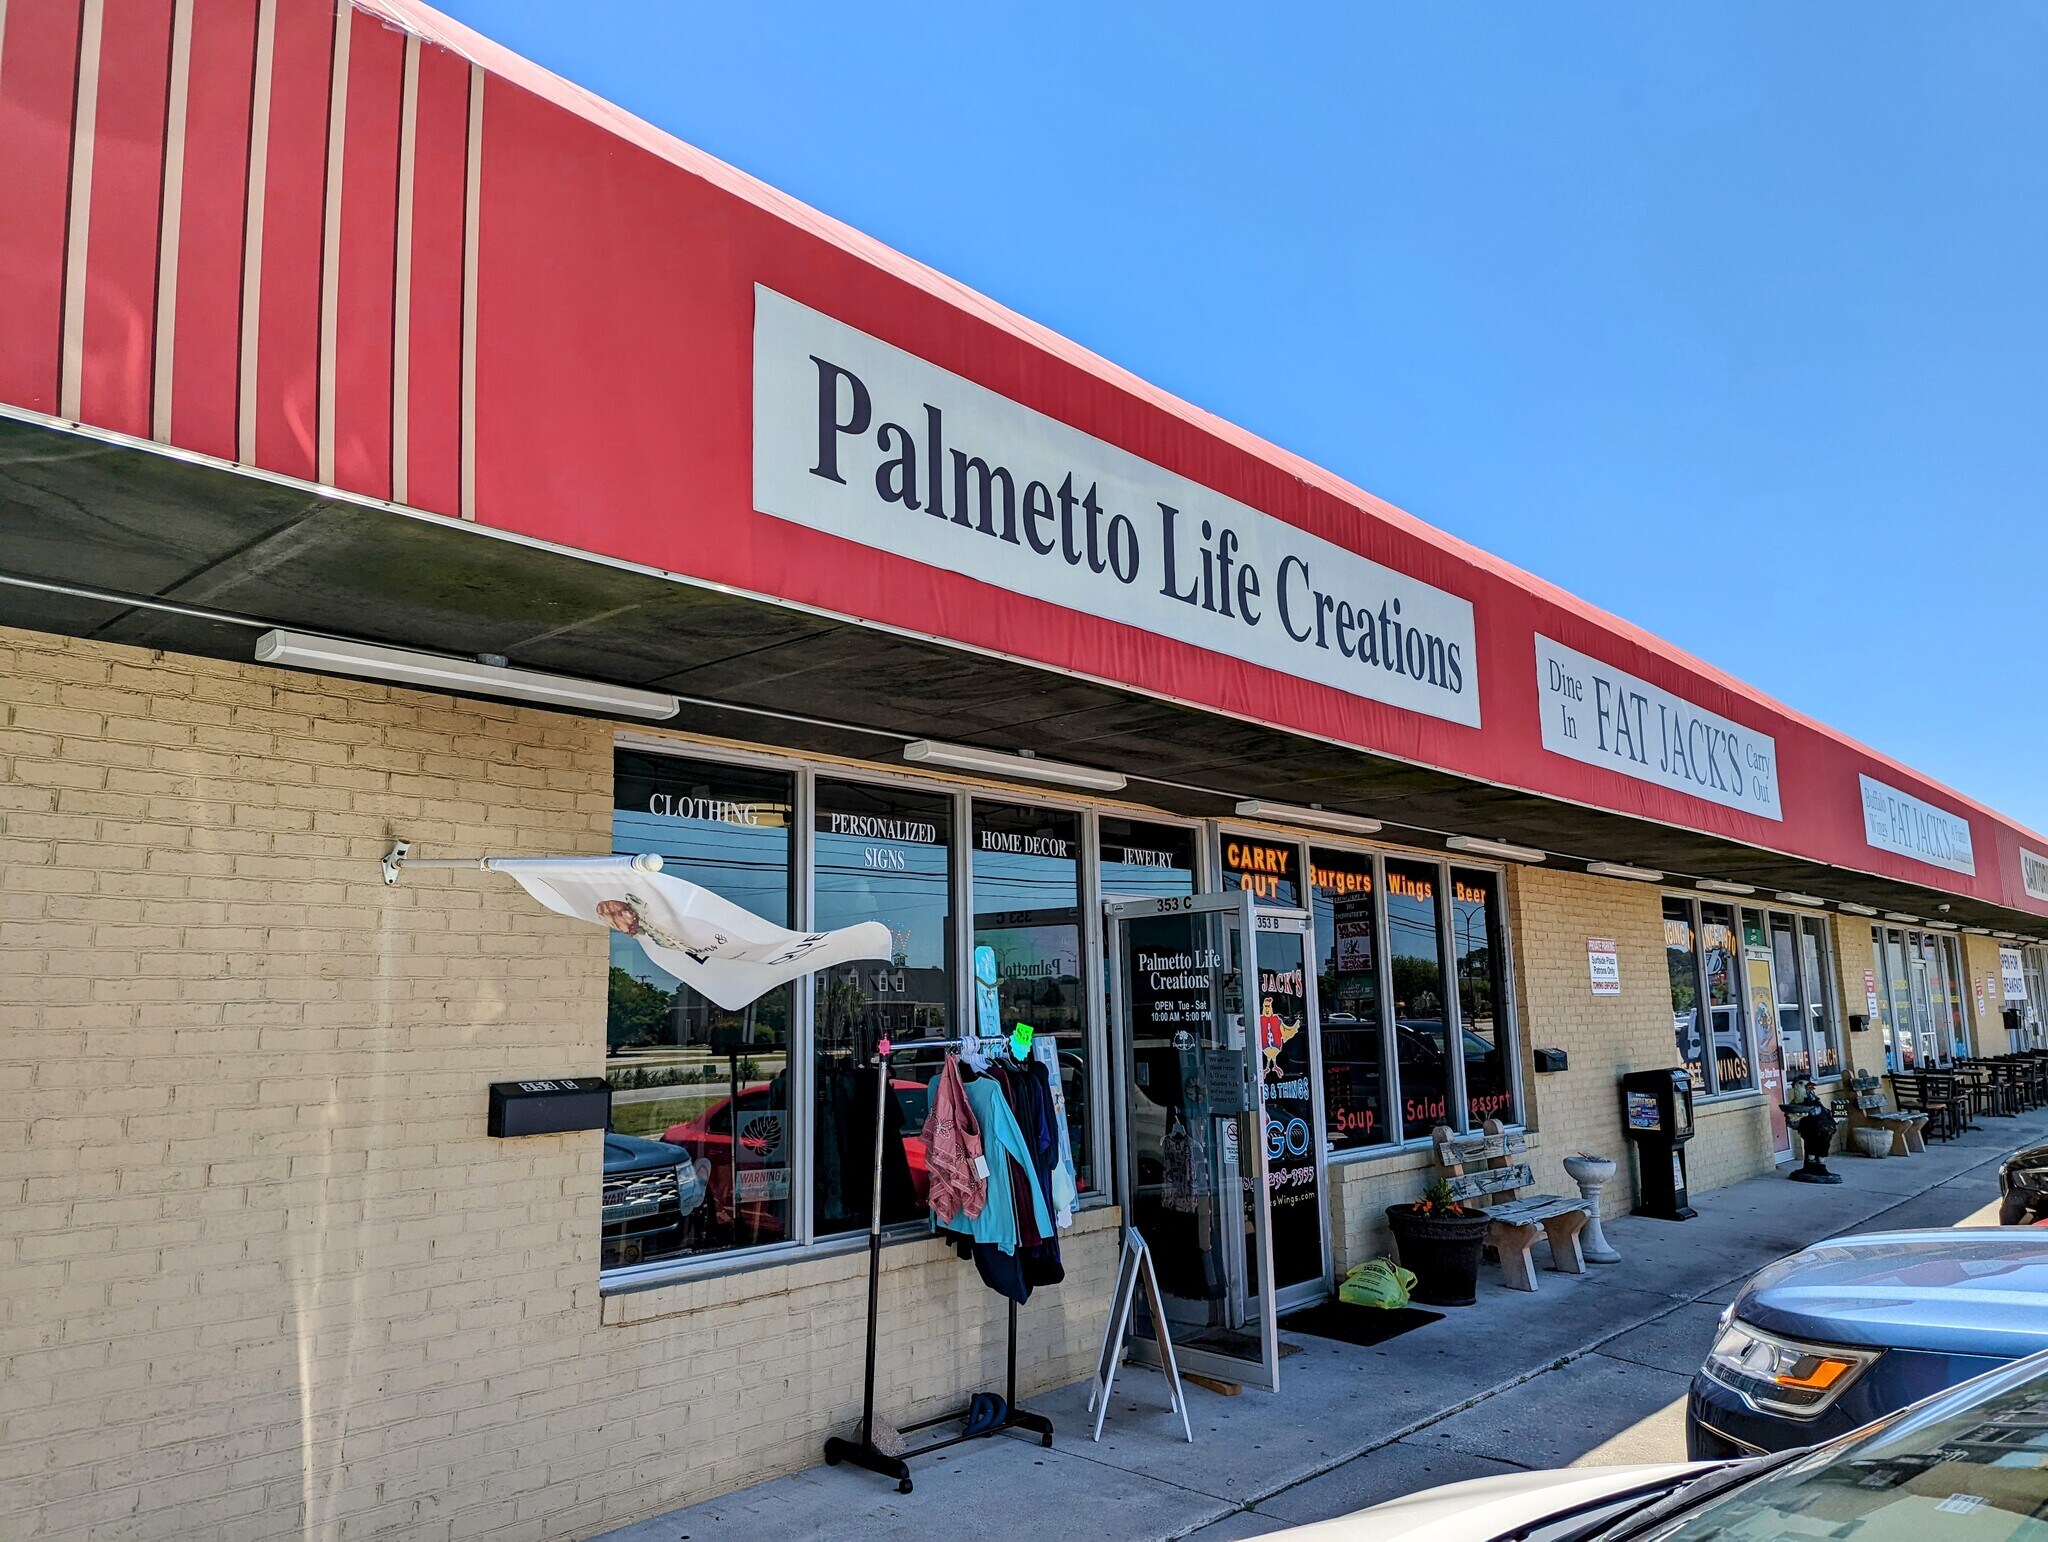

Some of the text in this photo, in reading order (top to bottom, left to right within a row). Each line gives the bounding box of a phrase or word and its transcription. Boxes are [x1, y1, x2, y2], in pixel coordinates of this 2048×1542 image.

[809, 354, 1464, 695] Palmetto Life Creations
[1548, 658, 1583, 702] Dine
[1561, 704, 1577, 739] In
[1592, 675, 1743, 797] FAT JACK'S
[1745, 743, 1770, 780] Carry
[1753, 776, 1770, 803] Out
[1864, 787, 1887, 813] Buffalo
[650, 793, 758, 826] CLOTHING
[830, 812, 936, 843] PERSONALIZED
[1868, 813, 1888, 843] Wings
[1887, 796, 1951, 861] FAT JACK'S
[981, 830, 1067, 857] HOME DECOR
[864, 847, 905, 870] SIGNS
[1121, 847, 1173, 868] JEWELRY
[1227, 843, 1289, 873] CARRY
[1241, 872, 1278, 899] OUT
[1310, 863, 1372, 896] Burgers
[1388, 873, 1432, 903] Wings
[1456, 881, 1486, 904] Beer
[1157, 896, 1192, 912] 353 C
[1257, 918, 1279, 929] 353 B
[1138, 949, 1221, 972] Palmetto Life
[1593, 965, 1615, 976] Patrons Only
[2001, 954, 2011, 969] PEN
[1150, 971, 1209, 991] Creations
[1261, 969, 1303, 998] JACK'S
[1151, 1012, 1168, 1021] 10:00
[1169, 1012, 1180, 1021] AM
[1185, 1012, 1199, 1021] 5:00
[1201, 1012, 1212, 1021] PM
[1155, 1001, 1174, 1010] OPEN
[1178, 1001, 1190, 1010] Tue
[1195, 1000, 1207, 1010] Sat
[1793, 1050, 1809, 1071] THE
[1817, 1047, 1838, 1068] EACH
[518, 1081, 560, 1092] 353
[1271, 1084, 1277, 1099] &
[1277, 1077, 1309, 1100] THINGS
[1337, 1108, 1374, 1134] Soup
[1407, 1095, 1446, 1121] Salad
[1265, 1118, 1309, 1159] GO
[740, 1171, 781, 1184] WARNING
